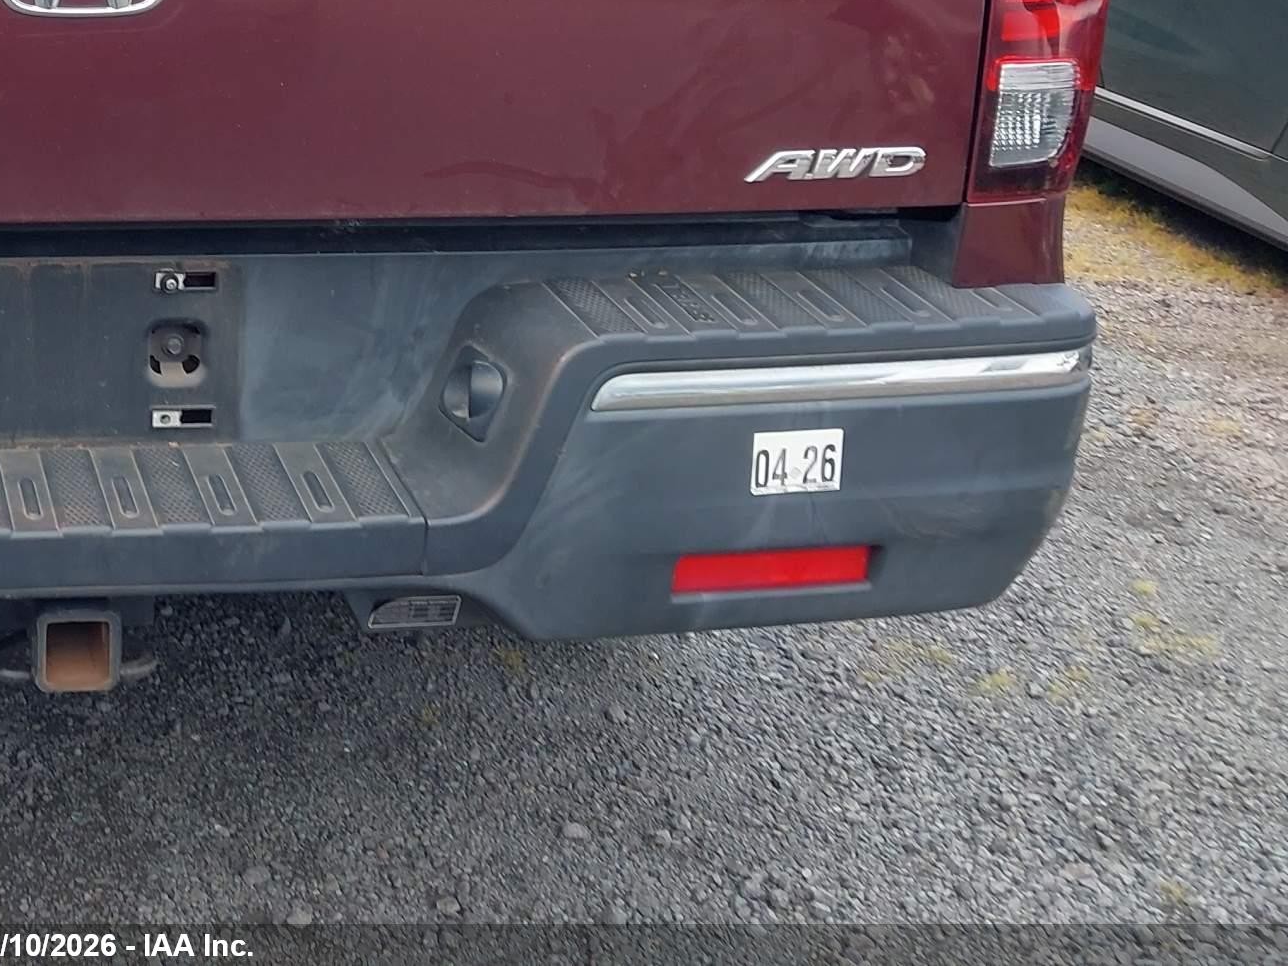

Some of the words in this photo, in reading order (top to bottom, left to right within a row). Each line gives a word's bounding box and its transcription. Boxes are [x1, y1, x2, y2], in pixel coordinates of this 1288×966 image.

[743, 146, 927, 183] AWD
[755, 447, 788, 489] 04
[802, 443, 837, 485] 26
